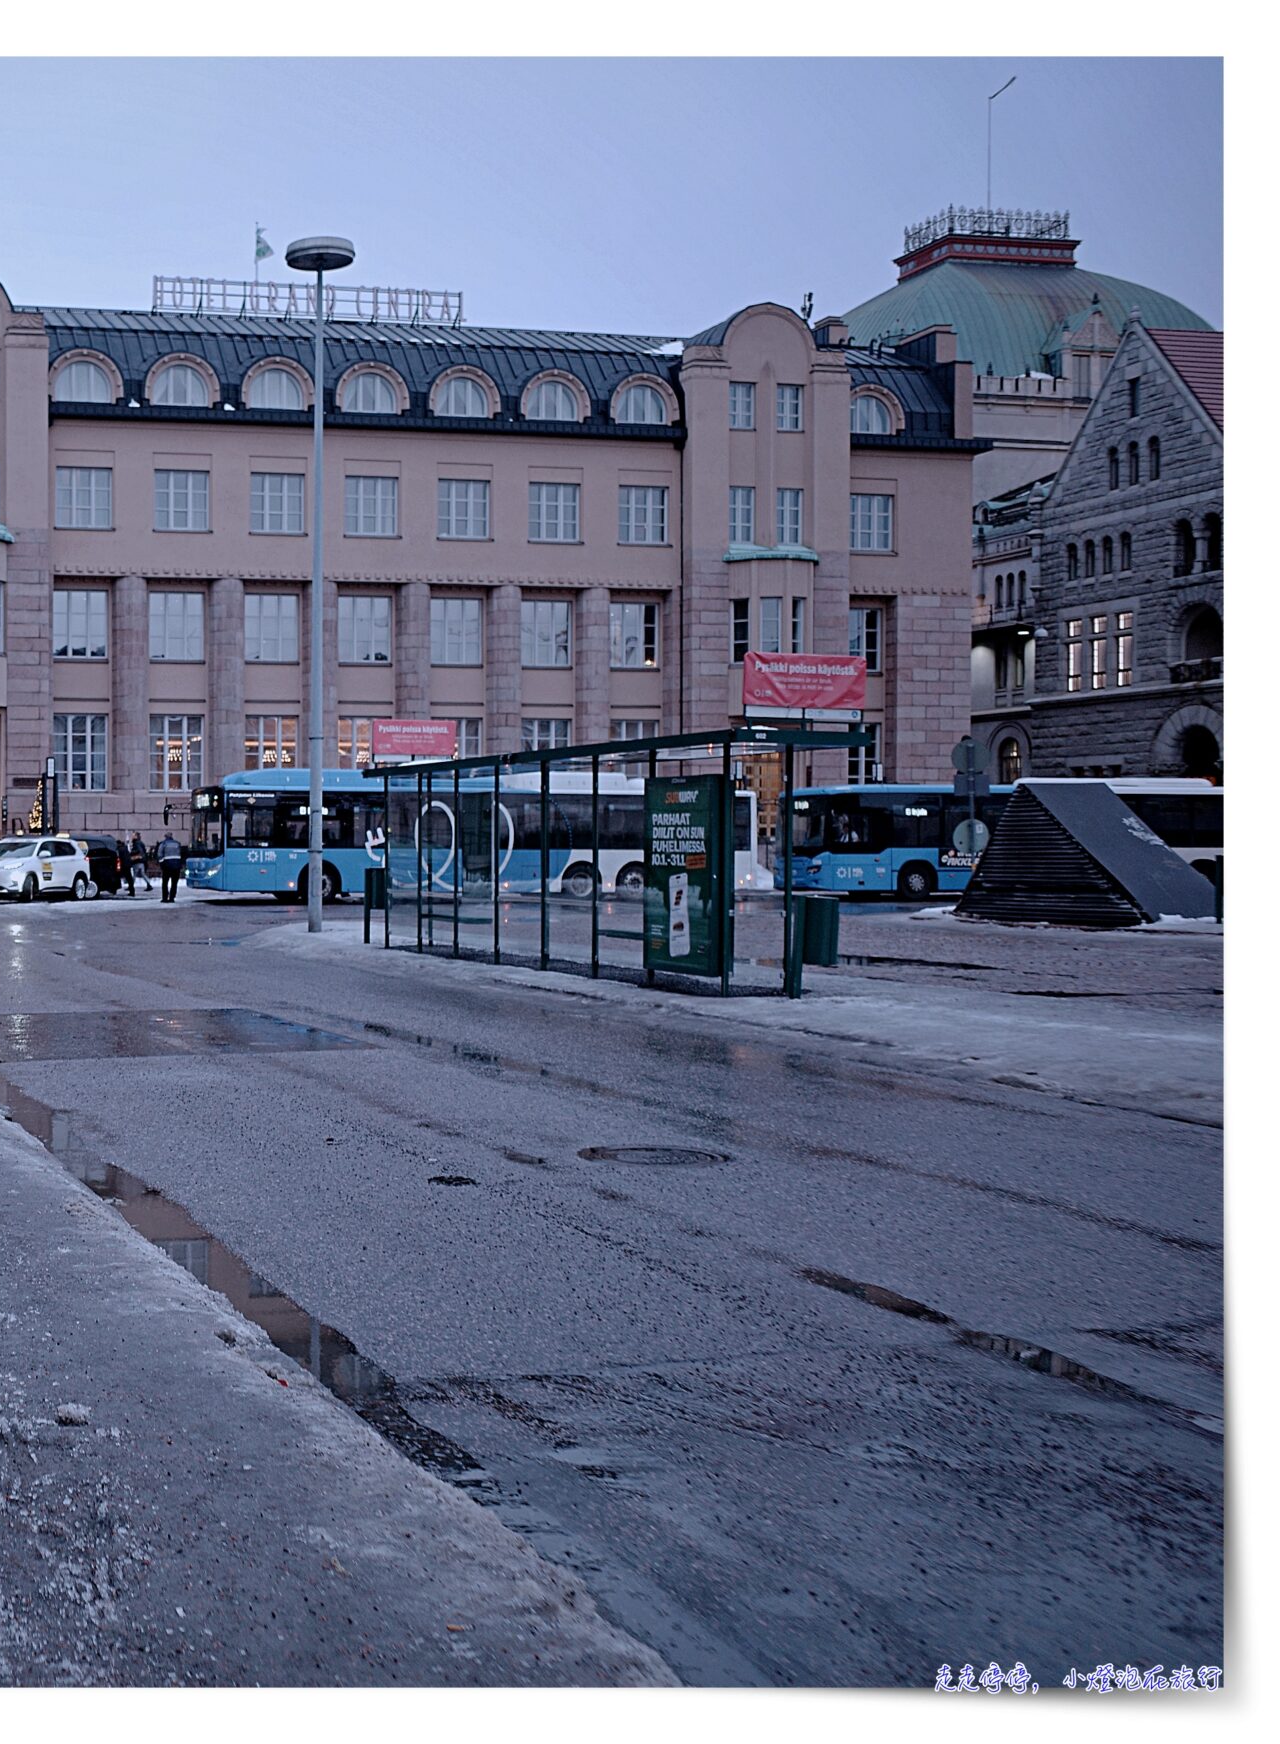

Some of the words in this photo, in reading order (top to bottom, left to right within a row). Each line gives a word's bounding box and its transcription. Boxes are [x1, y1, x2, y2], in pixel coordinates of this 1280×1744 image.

[152, 275, 231, 311] HOTEL
[249, 280, 336, 315] GRAND
[356, 285, 468, 323] CENTRAL
[789, 664, 817, 675] poissa
[818, 664, 858, 677] käytöstä.
[402, 726, 422, 735] poissa
[665, 790, 698, 804] SUBWAY
[652, 813, 690, 825] PARHAAT
[652, 827, 675, 839] DIILIT
[676, 827, 690, 839] ON
[690, 827, 705, 839] SUN
[652, 840, 706, 853] PUHELIMESSA
